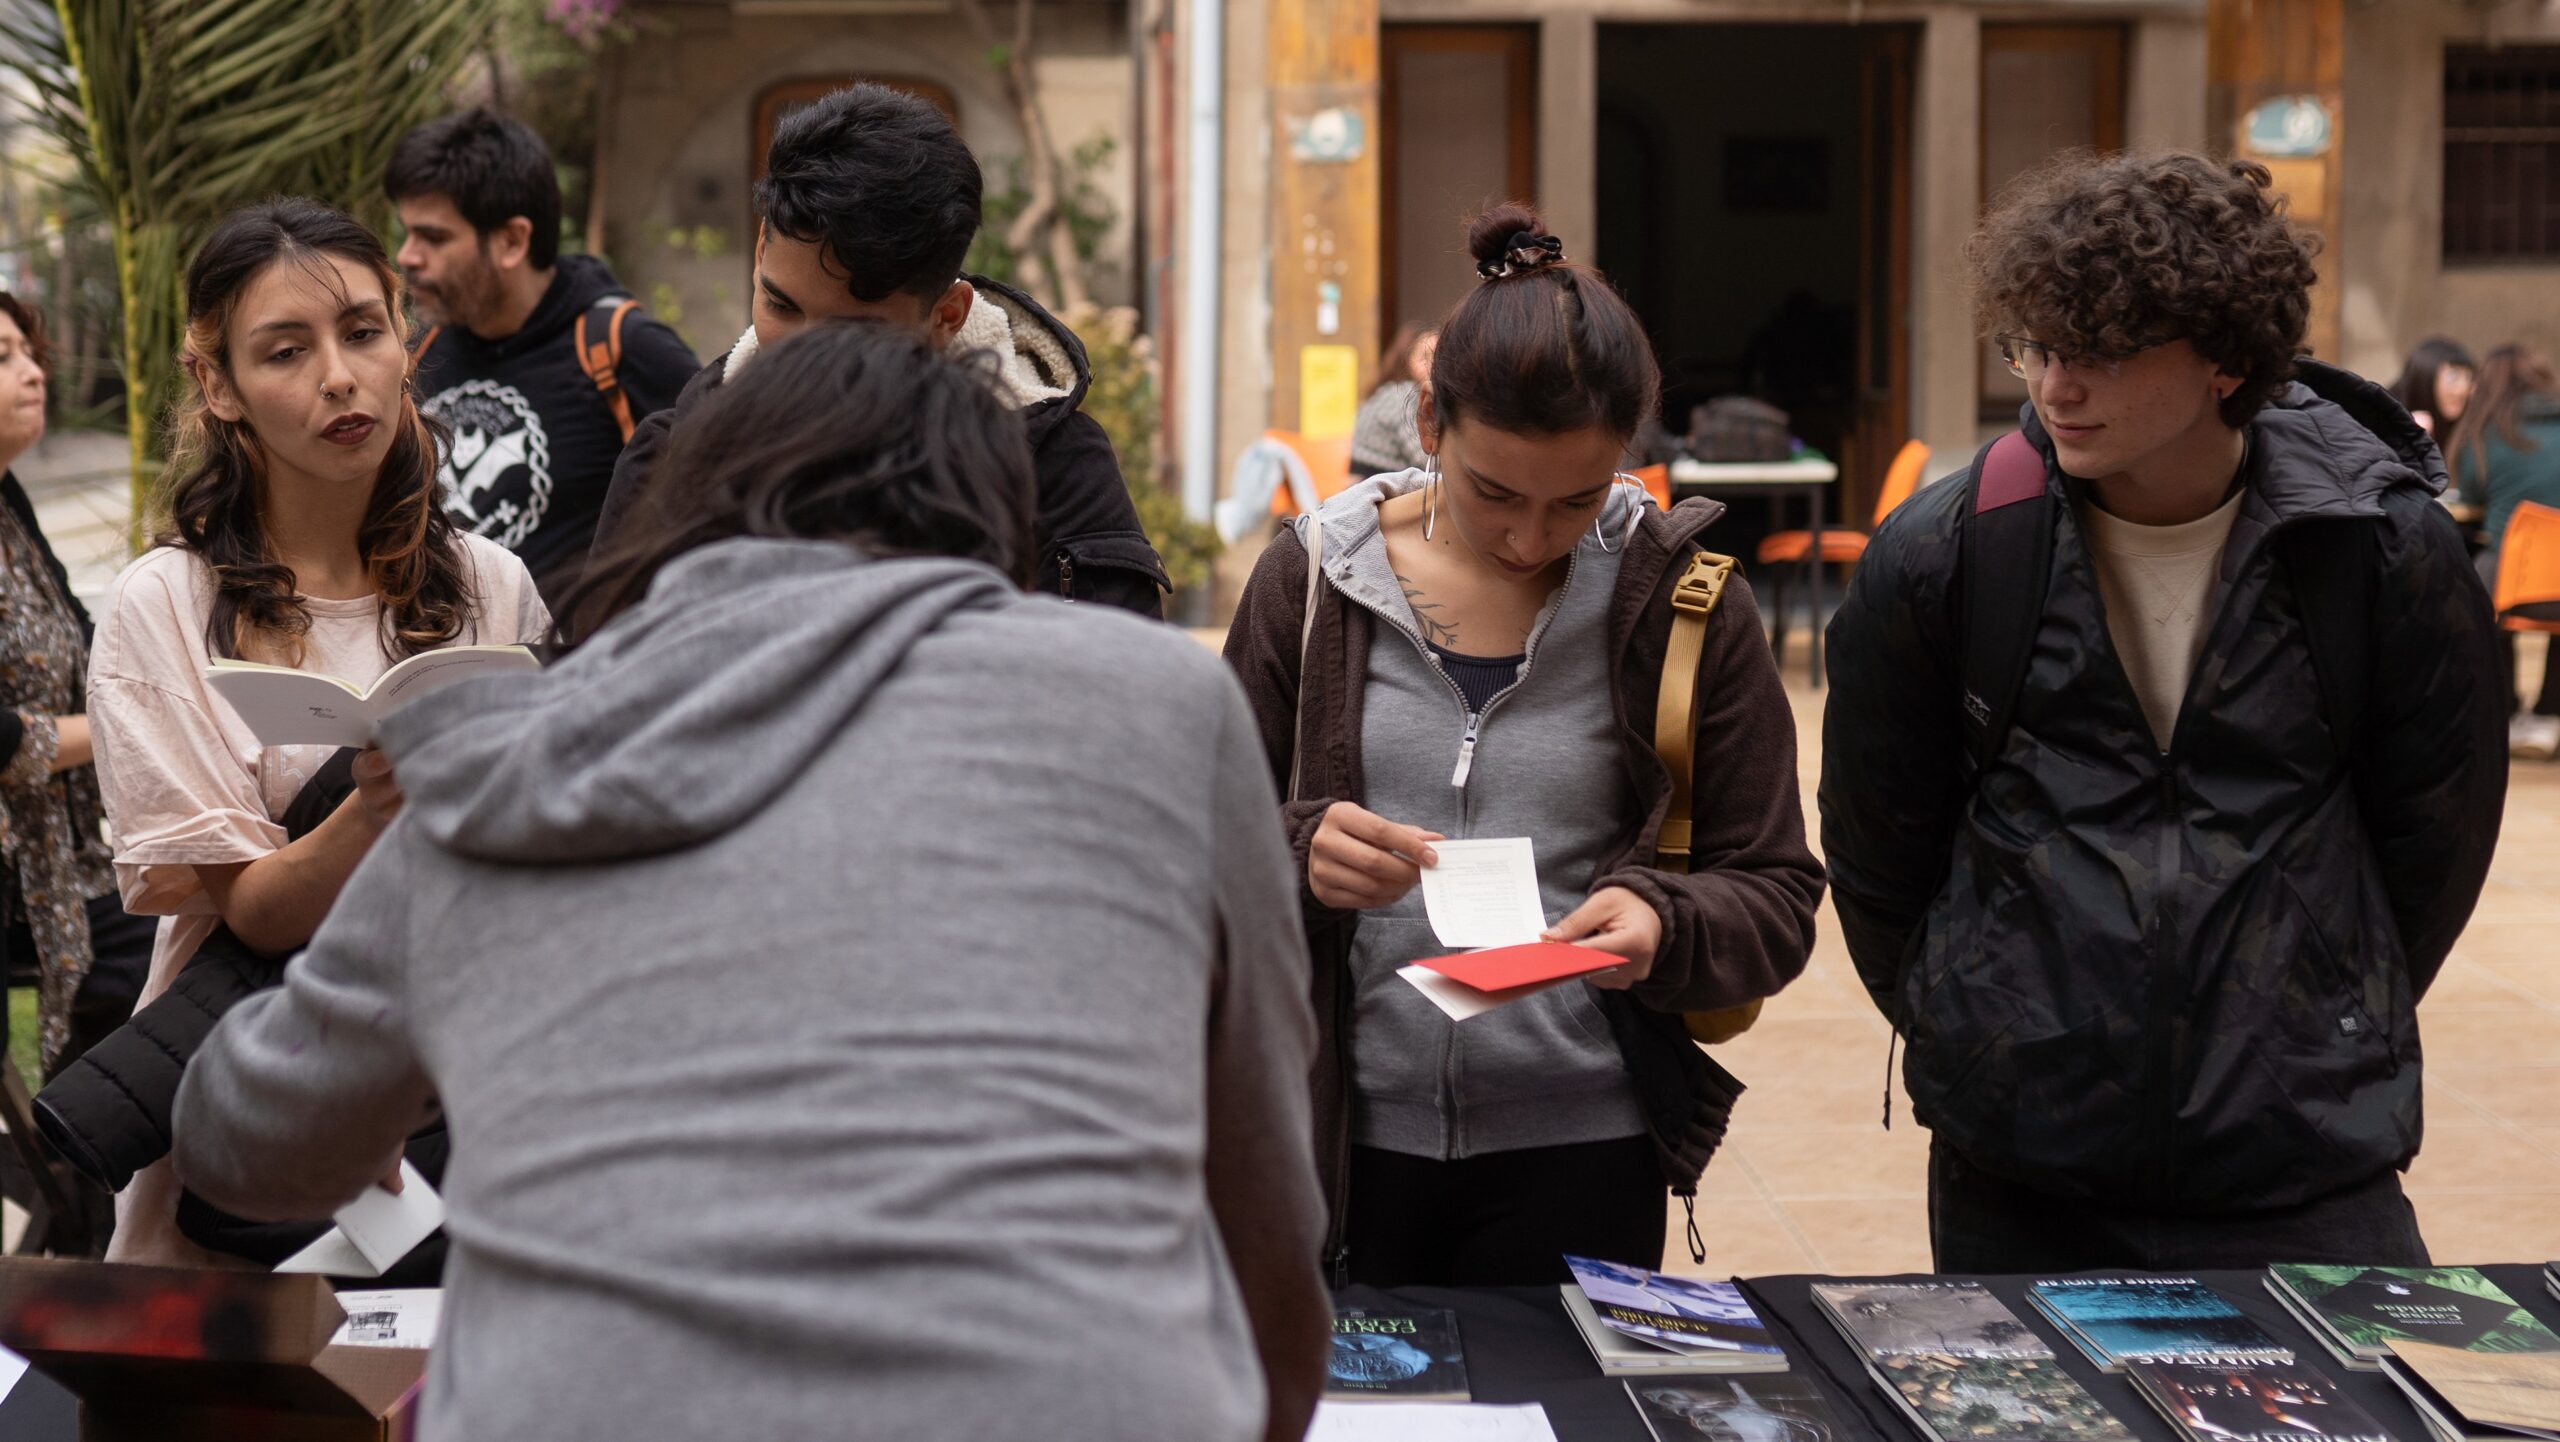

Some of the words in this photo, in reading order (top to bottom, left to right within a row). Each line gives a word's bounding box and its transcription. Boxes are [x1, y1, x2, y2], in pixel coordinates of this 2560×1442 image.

[2372, 1304, 2461, 1313] perdidas
[2388, 1311, 2462, 1320] Causas
[1332, 1325, 1417, 1334] CONT
